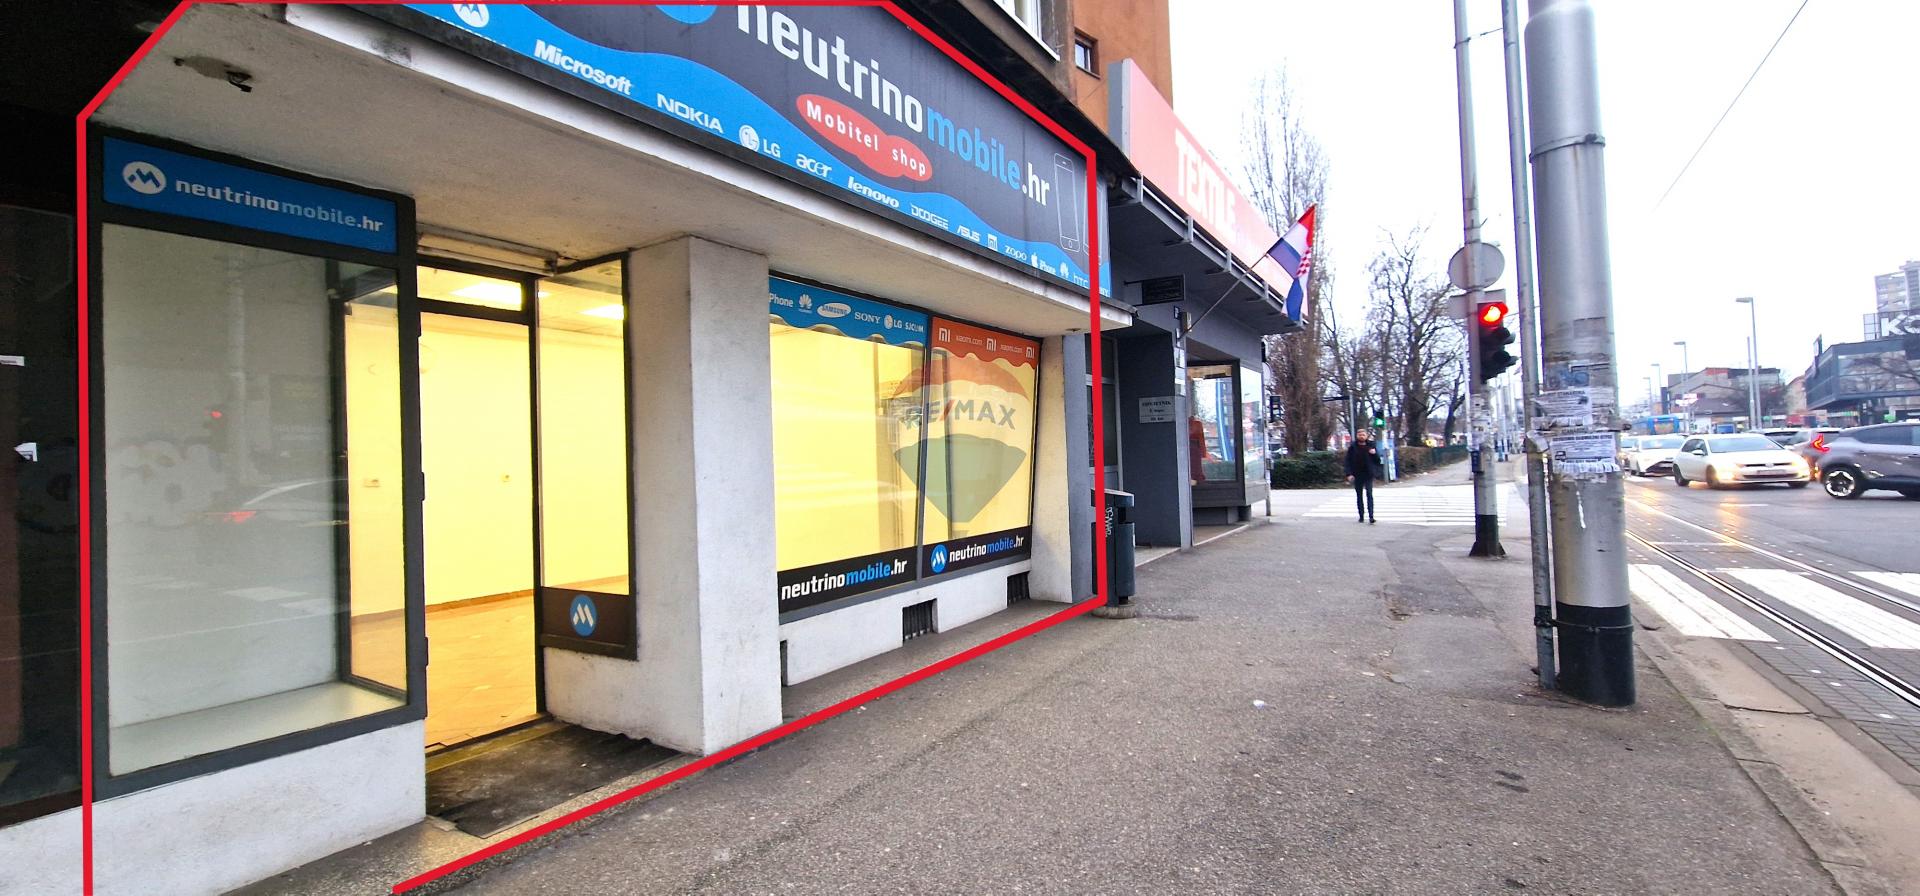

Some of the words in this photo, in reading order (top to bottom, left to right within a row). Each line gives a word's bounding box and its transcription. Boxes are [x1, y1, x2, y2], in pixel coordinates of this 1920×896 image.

[736, 5, 1050, 206] neutrinomobile.hr
[533, 39, 632, 95] Microsoft
[656, 93, 723, 133] NOKIA
[763, 139, 781, 158] LG
[796, 153, 833, 178] acer
[848, 175, 900, 208] lenovo
[957, 225, 981, 243] ASUS
[806, 100, 880, 152] Mobitel
[892, 147, 926, 177] shop
[175, 178, 384, 232] neutrinomobile.hr
[768, 292, 794, 308] Phone
[854, 311, 881, 324] SONY
[894, 319, 903, 329] LG
[949, 534, 1024, 563] neutrinomobile.hr
[780, 557, 907, 600] neutrinomobile.hr
